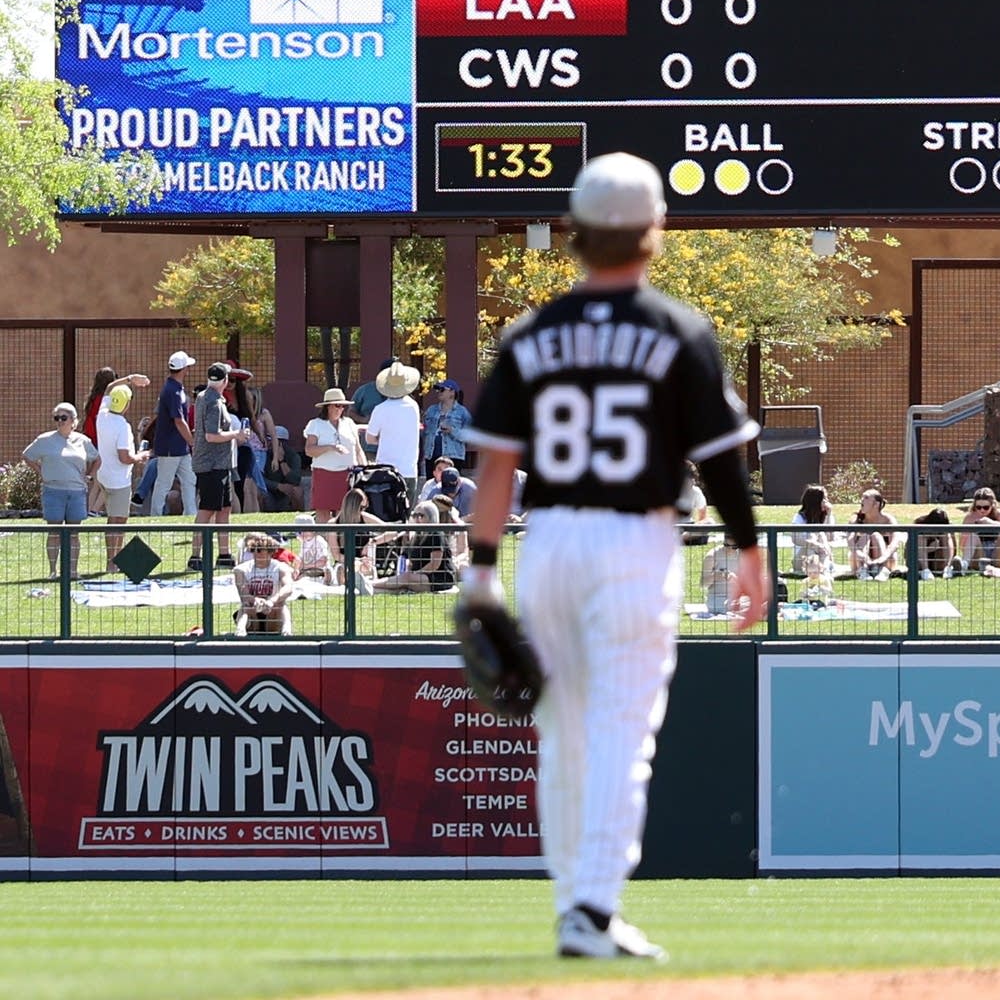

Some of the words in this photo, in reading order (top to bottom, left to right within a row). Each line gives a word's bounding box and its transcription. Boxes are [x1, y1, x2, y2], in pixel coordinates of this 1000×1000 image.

[77, 23, 384, 60] Mortenson
[458, 48, 581, 89] CWS
[661, 52, 693, 89] 0
[725, 52, 757, 89] 0
[72, 108, 199, 149] PROUD
[210, 106, 405, 147] PARTNERS
[684, 122, 783, 152] BALL
[297, 160, 386, 191] RANCH
[469, 142, 553, 179] 1:33
[533, 384, 651, 484] 85
[415, 680, 478, 708] Arizon
[103, 736, 220, 812] TWIN
[234, 736, 374, 812] PEAKS
[462, 795, 527, 810] TEMPE
[92, 825, 135, 841] EATS
[161, 825, 228, 841] DRINKS
[253, 825, 315, 841] SCENIC
[320, 825, 377, 841] VIEWS
[432, 822, 484, 838] DEER
[491, 822, 548, 838] VALLE
